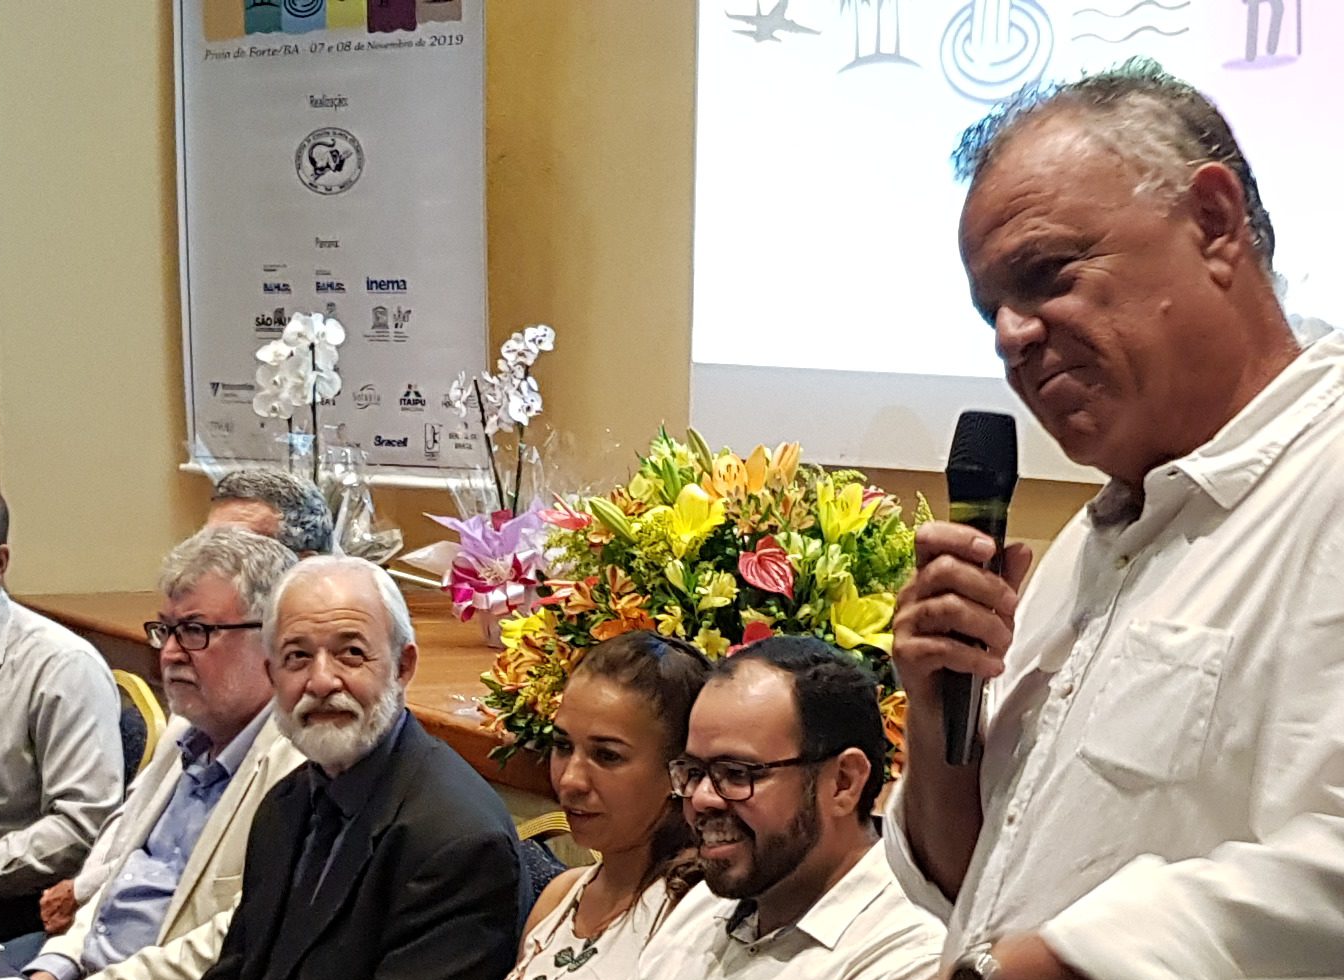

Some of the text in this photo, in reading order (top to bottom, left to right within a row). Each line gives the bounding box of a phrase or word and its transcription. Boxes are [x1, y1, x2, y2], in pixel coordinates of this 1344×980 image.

[309, 42, 325, 53] 07
[336, 41, 351, 52] 08
[354, 41, 364, 51] de
[429, 34, 464, 47] 2019
[366, 276, 407, 291] inema
